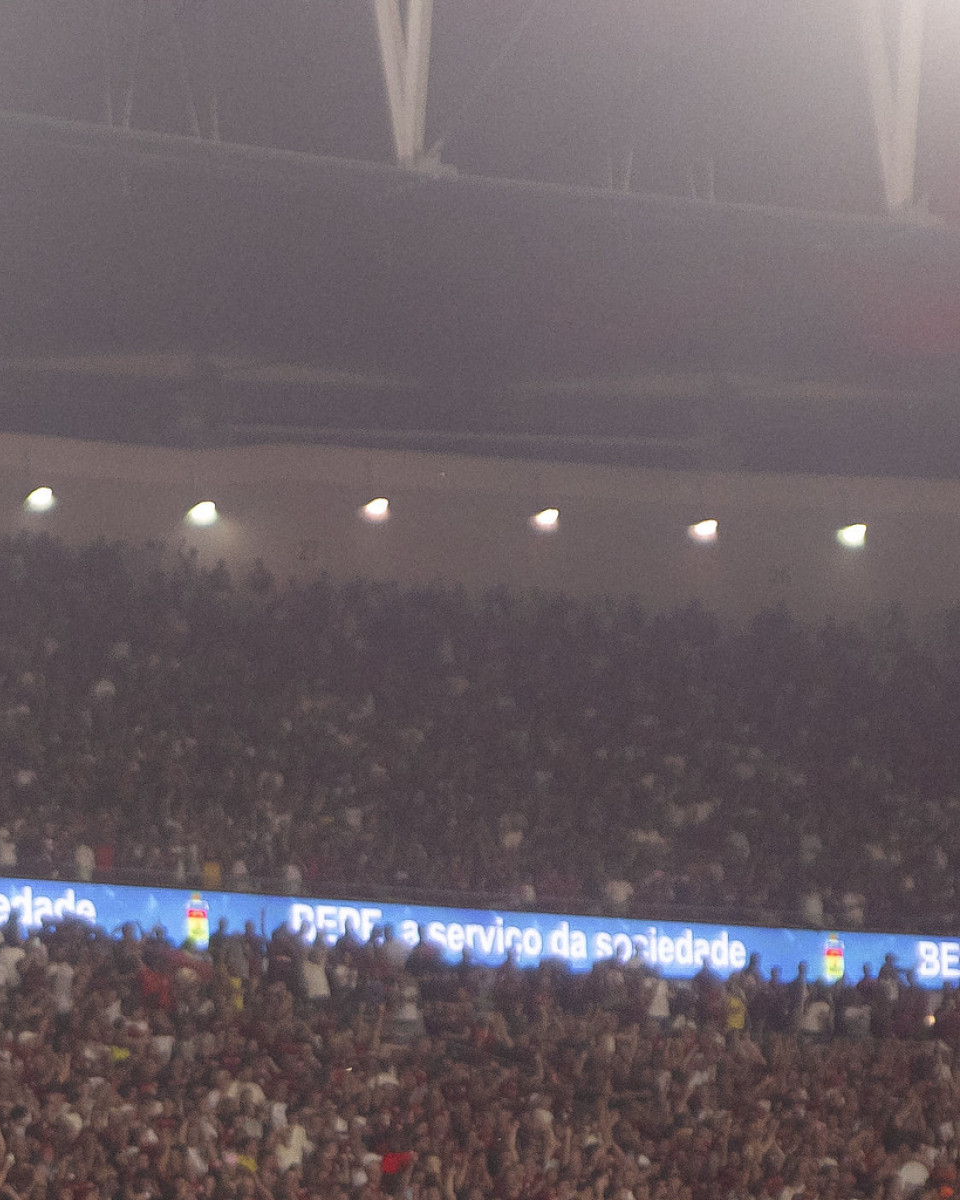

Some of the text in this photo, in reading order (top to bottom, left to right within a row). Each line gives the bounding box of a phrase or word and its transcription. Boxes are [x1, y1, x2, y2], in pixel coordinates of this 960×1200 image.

[401, 919, 420, 947] a
[550, 920, 588, 960] da
[916, 940, 960, 978] BE
